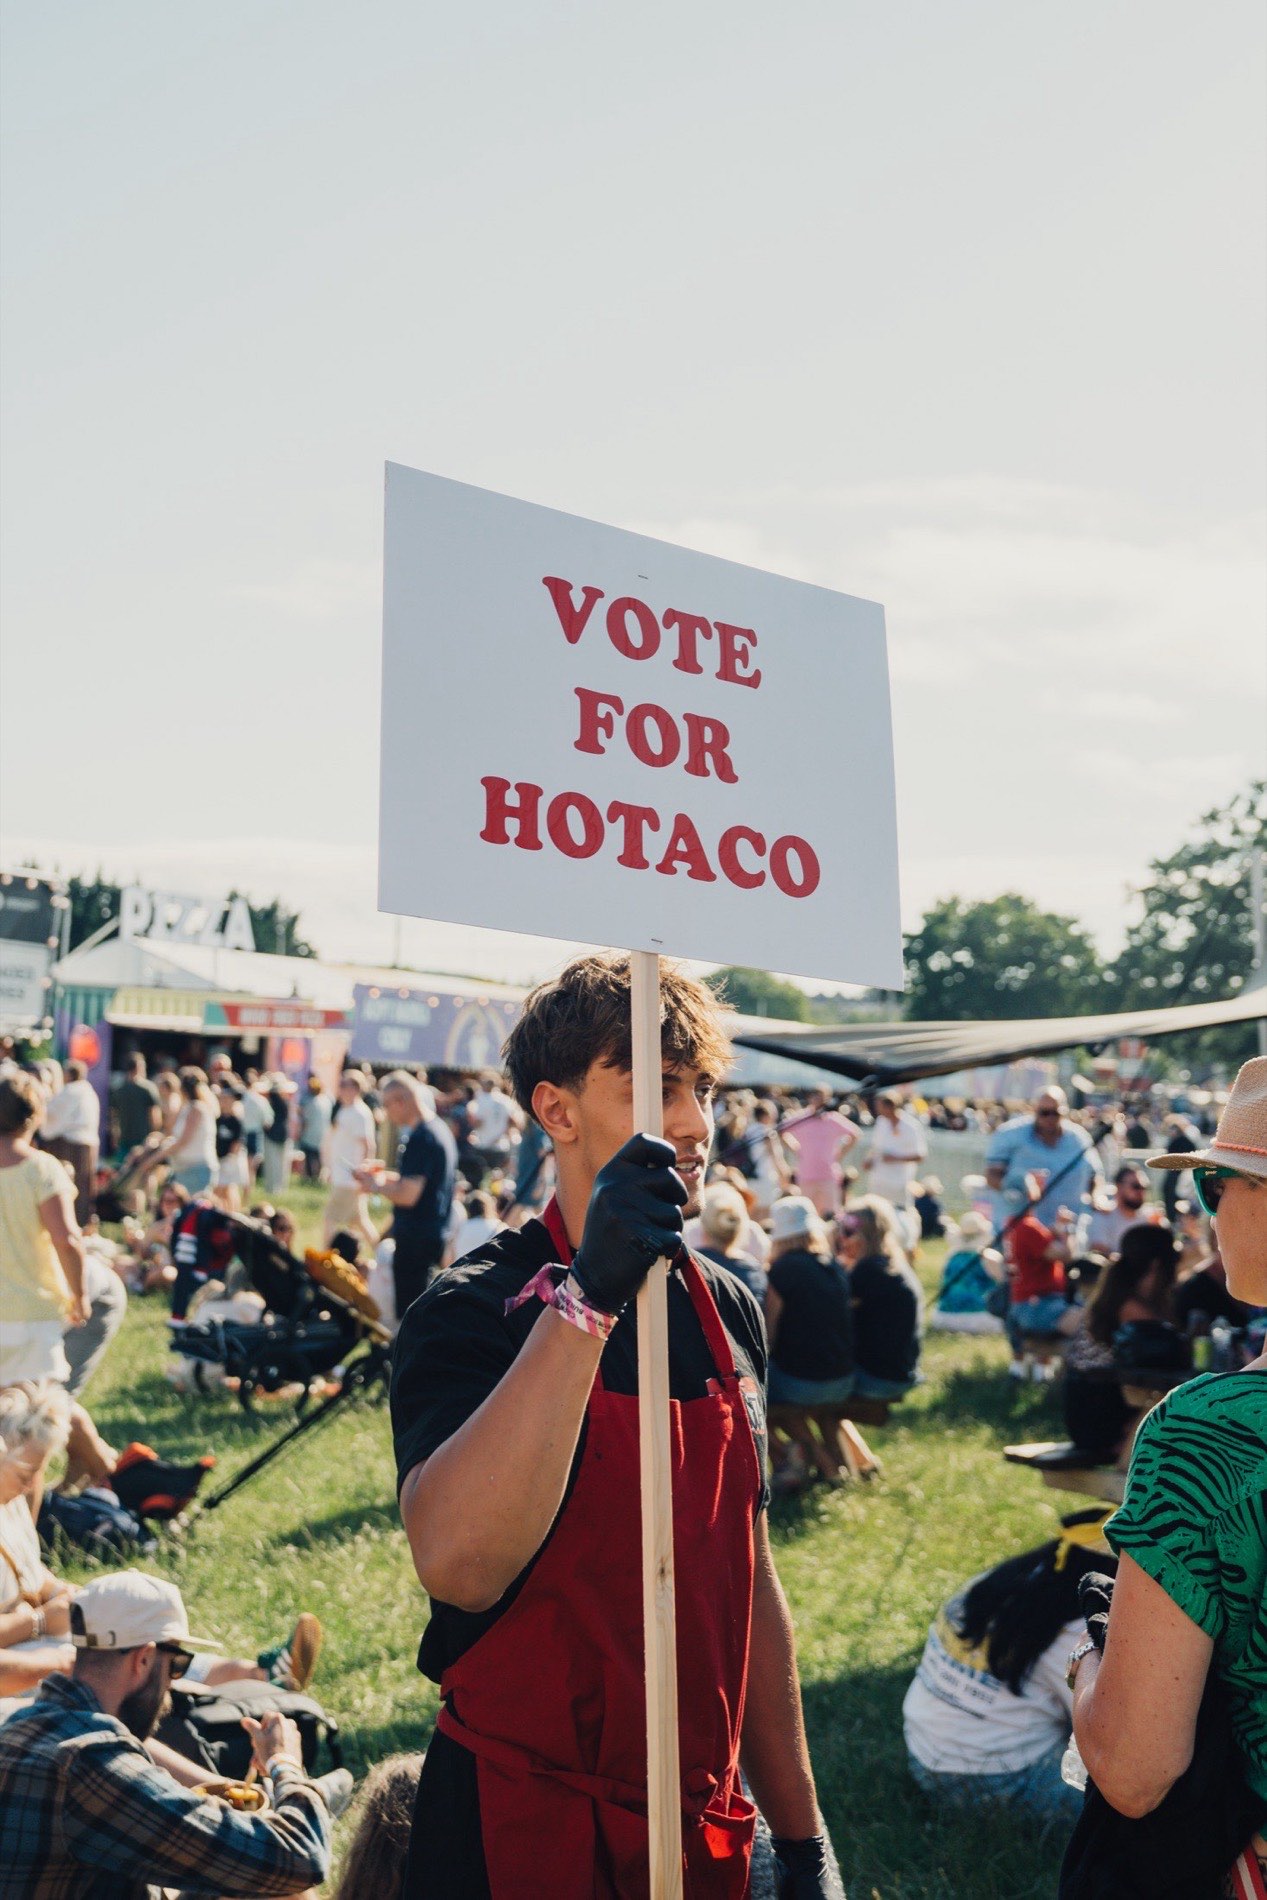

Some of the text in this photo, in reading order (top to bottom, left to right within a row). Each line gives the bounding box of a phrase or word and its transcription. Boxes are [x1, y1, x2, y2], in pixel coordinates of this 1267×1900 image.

[543, 576, 762, 689] VOTE
[574, 687, 739, 784] FOR
[479, 775, 821, 899] HOTACO
[119, 886, 256, 952] PIZZA
